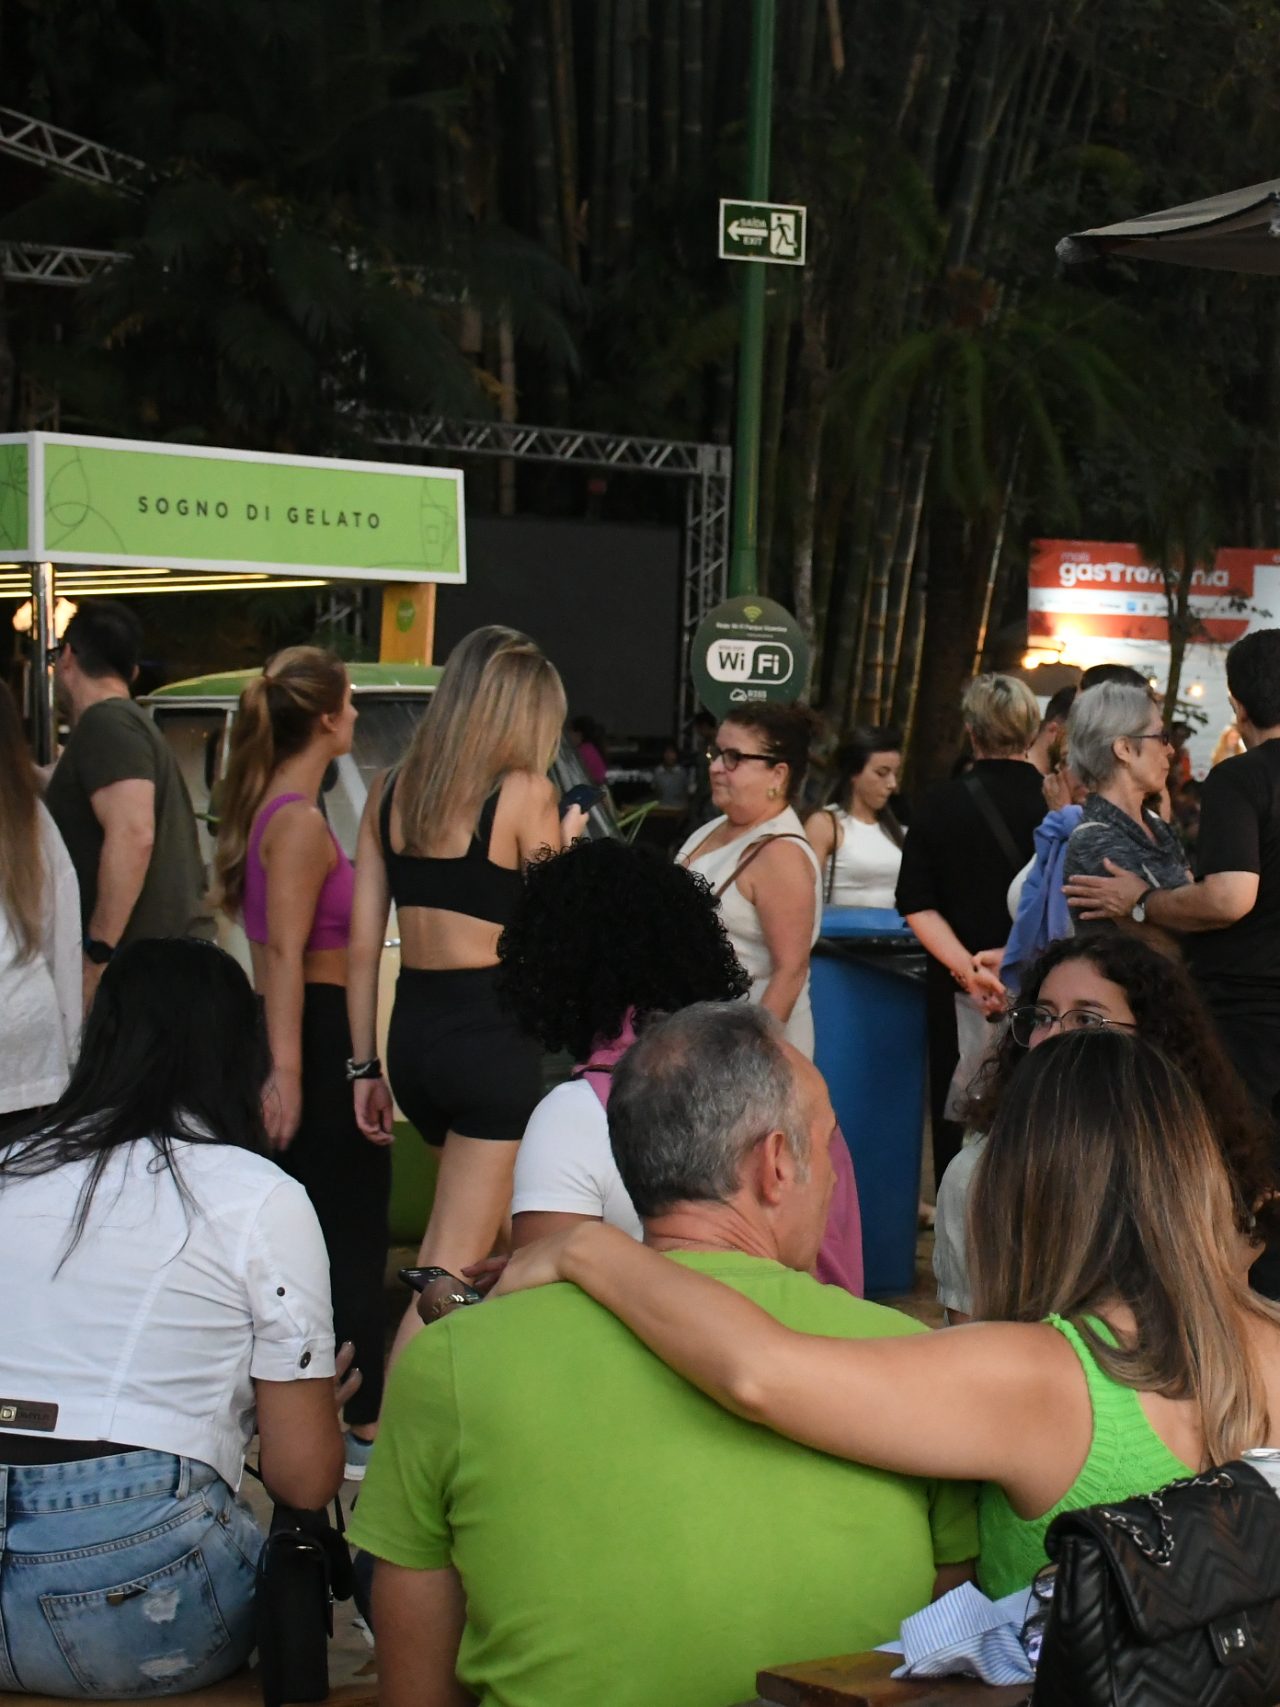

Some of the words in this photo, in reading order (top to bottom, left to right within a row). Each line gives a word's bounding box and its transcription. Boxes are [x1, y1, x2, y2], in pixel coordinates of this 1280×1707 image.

[742, 236, 762, 246] EXIT
[138, 496, 229, 519] SOGNO
[246, 504, 270, 521] DI
[287, 507, 380, 529] GELATO
